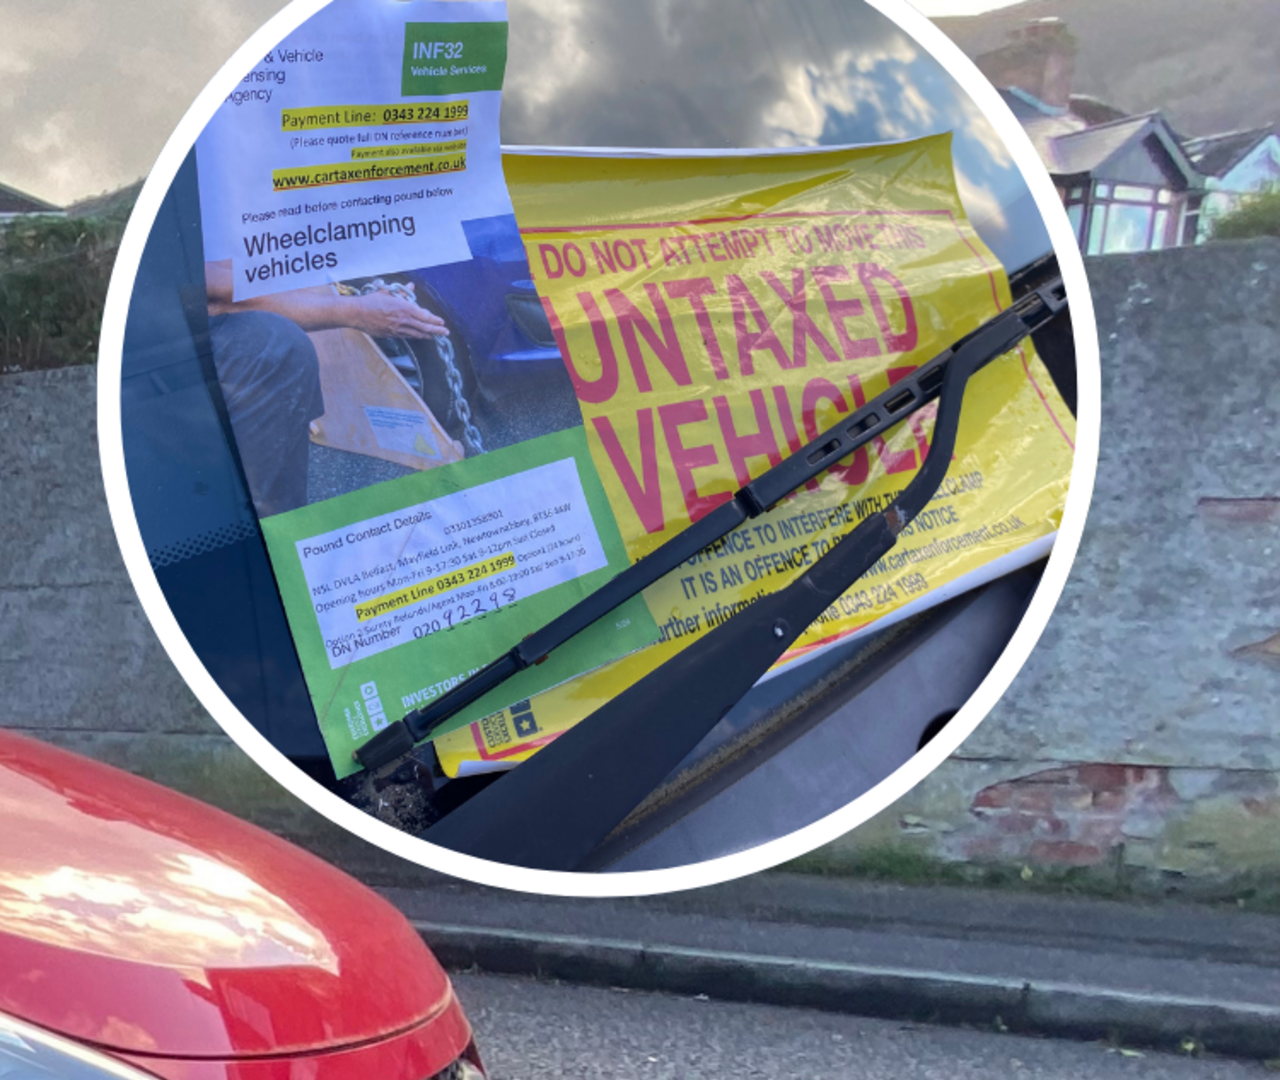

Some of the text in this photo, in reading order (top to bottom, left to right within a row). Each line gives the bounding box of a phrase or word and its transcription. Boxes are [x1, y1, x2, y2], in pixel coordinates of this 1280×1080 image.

[278, 49, 324, 63] Vehicle
[413, 42, 463, 59] INF32
[241, 70, 286, 85] ensing
[411, 65, 487, 77] Vehicle Services
[225, 88, 272, 106] Agency
[282, 105, 469, 129] Payment Line: 0343 224 1999
[290, 136, 325, 150] (Please
[326, 132, 354, 146] quote
[390, 129, 433, 141] reference
[351, 148, 384, 160] Payment
[402, 143, 432, 155] available
[273, 155, 467, 188] www.cartaxenforcement.co.uk
[242, 187, 454, 224] Please read before contacting pound below
[243, 214, 417, 258] Wheelclamping
[538, 222, 927, 280] DO NOT ATTEMPT TO MOVE THIS
[244, 250, 339, 284] vehicles
[540, 262, 920, 404] UNTAXED
[591, 364, 956, 535] VEHICLE
[303, 510, 433, 559] Pound Contact Details
[753, 523, 777, 546] TO
[777, 502, 853, 540] INTERFERE
[854, 493, 883, 519] WITH
[315, 593, 357, 614] Opening
[358, 583, 386, 599] hours
[529, 524, 556, 540] Closed
[681, 575, 697, 600] IT
[699, 571, 719, 595] IS
[720, 564, 744, 589] AN
[743, 544, 813, 582] OFFENCE
[915, 504, 960, 535] NOTICE
[312, 584, 333, 597] NSL
[334, 574, 361, 590] DVLA
[356, 592, 409, 620] Payment
[411, 582, 435, 600] Line
[436, 573, 465, 590] 0343
[467, 565, 488, 581] 224
[489, 555, 516, 573] 1999
[839, 590, 873, 616] 0343
[873, 581, 899, 606] 224
[896, 572, 929, 597] 1999
[325, 631, 356, 648] Option
[332, 644, 352, 659] DN
[354, 624, 402, 649] Number
[659, 611, 702, 643] urther
[401, 673, 466, 709] INVESTORS
[480, 717, 496, 749] CUSTO
